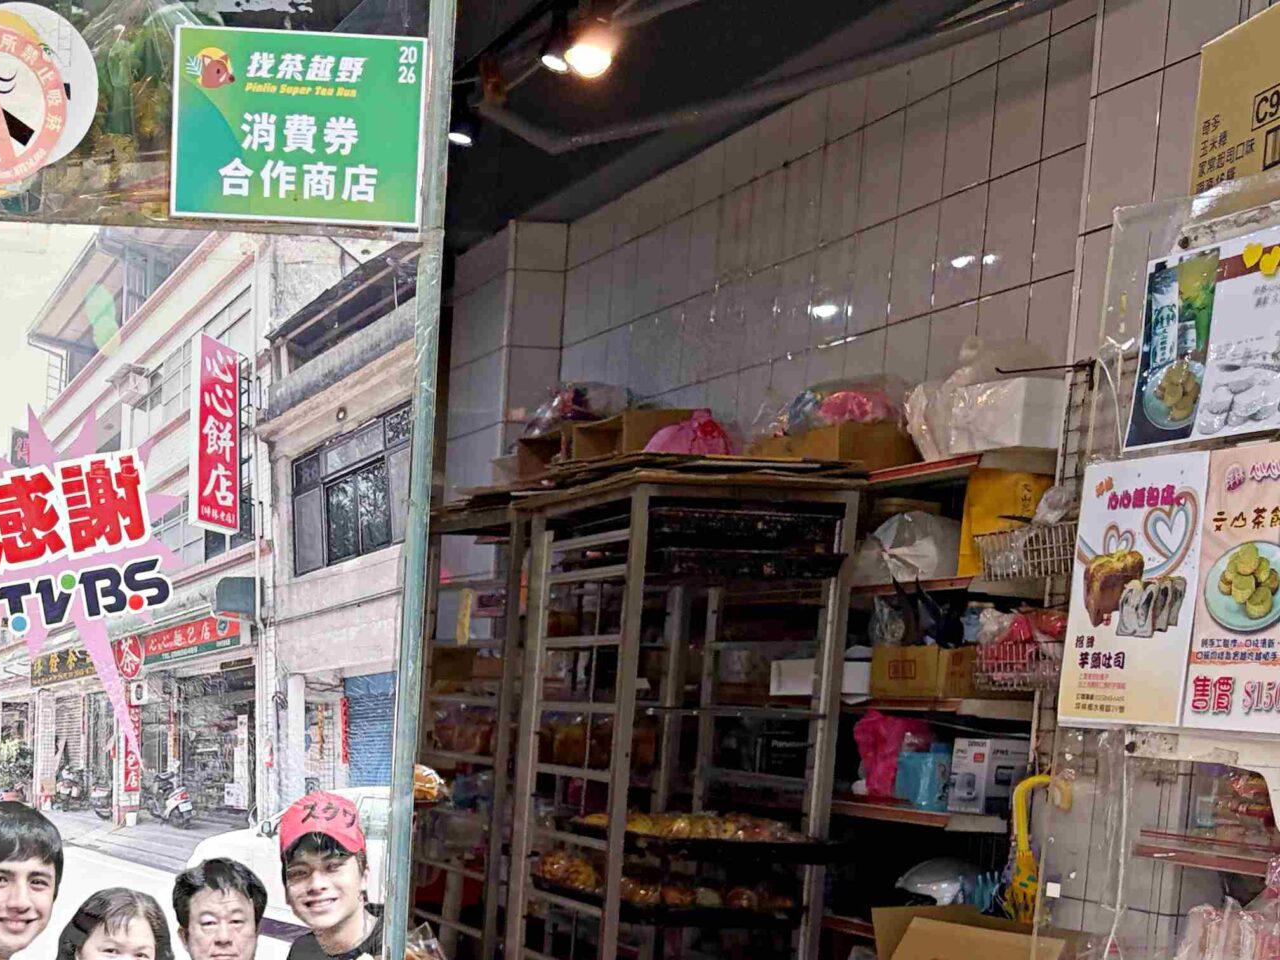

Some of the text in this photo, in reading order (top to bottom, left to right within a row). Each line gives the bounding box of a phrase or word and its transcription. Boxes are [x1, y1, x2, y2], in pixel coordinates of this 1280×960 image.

[245, 51, 369, 84] 找茶越野
[399, 46, 417, 64] 20
[279, 85, 311, 97] Super
[314, 86, 334, 96] Tea
[336, 87, 357, 97] Run
[398, 66, 416, 84] 26
[241, 112, 359, 155] 消費券
[219, 158, 378, 202] 合作商店
[202, 350, 235, 507] 心心餅店
[1192, 676, 1233, 711] 售價
